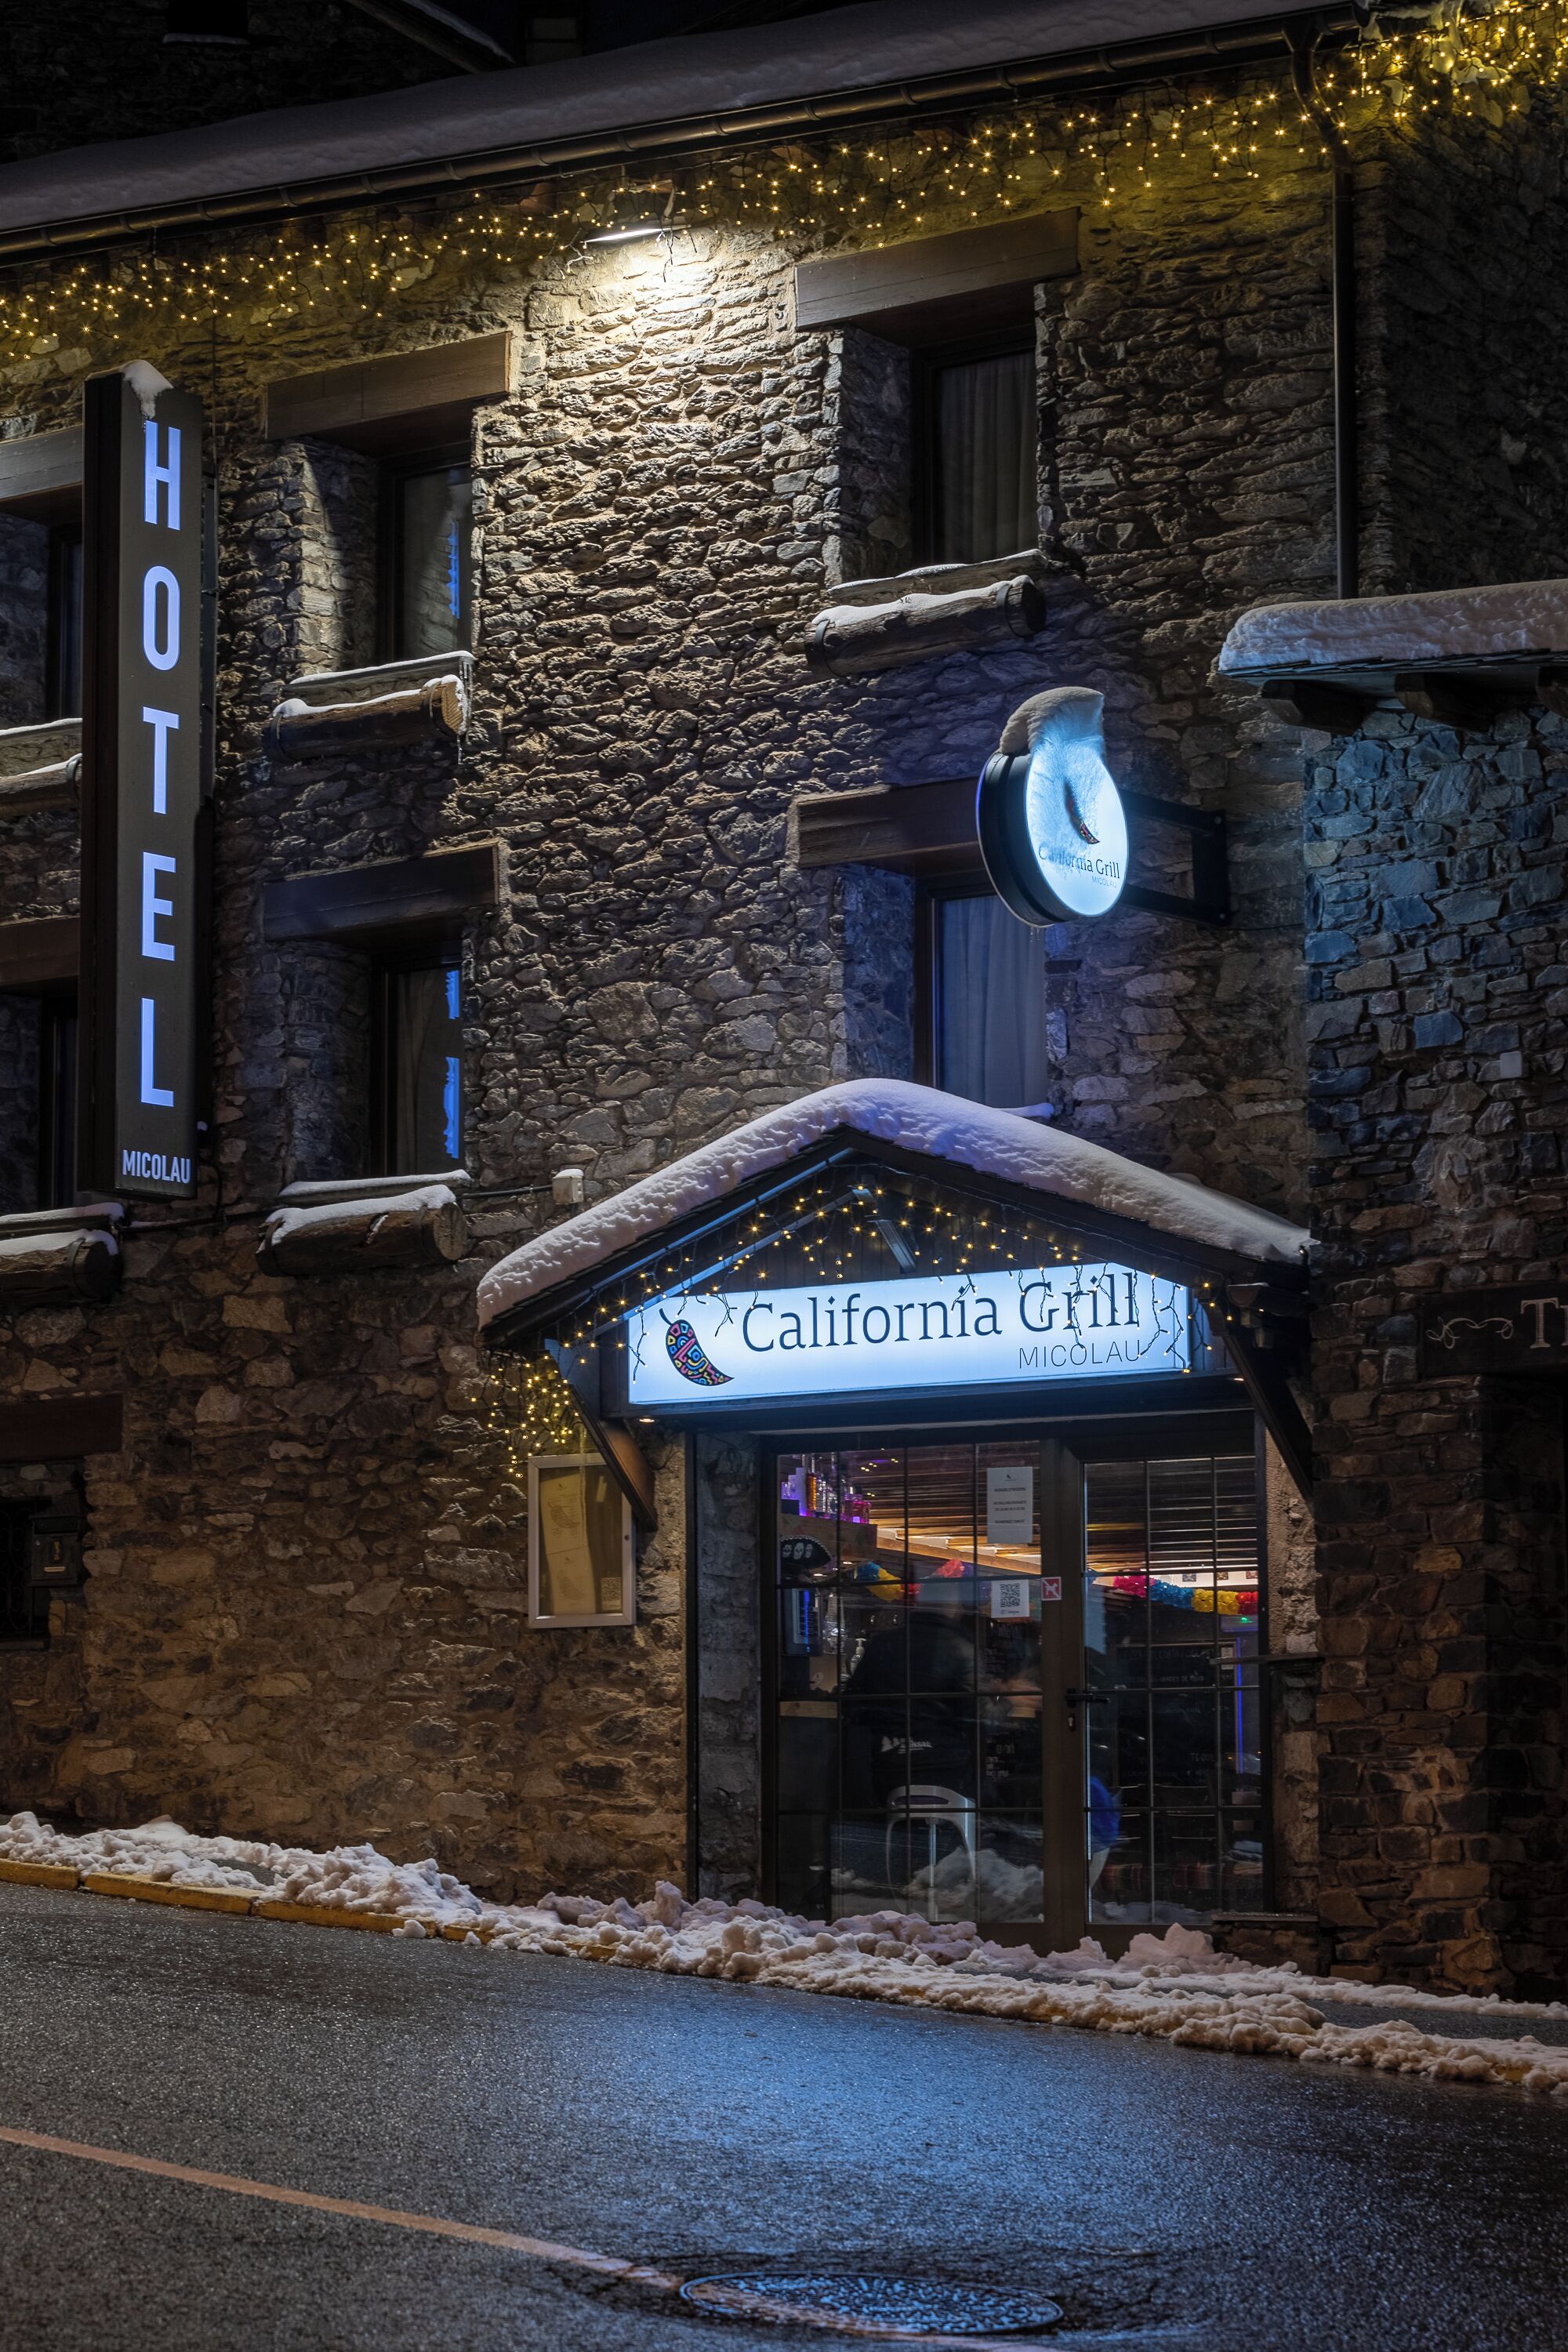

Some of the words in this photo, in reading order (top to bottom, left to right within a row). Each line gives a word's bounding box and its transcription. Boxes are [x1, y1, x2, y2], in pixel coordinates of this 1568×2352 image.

[141, 419, 180, 1107] HOTEL
[1091, 875, 1117, 888] MICOLAU
[1096, 858, 1120, 879] Grill
[122, 1149, 191, 1184] MICOLAU
[742, 1287, 1003, 1352] California
[1020, 1272, 1138, 1332] Grill
[1020, 1339, 1140, 1369] MICOLAU
